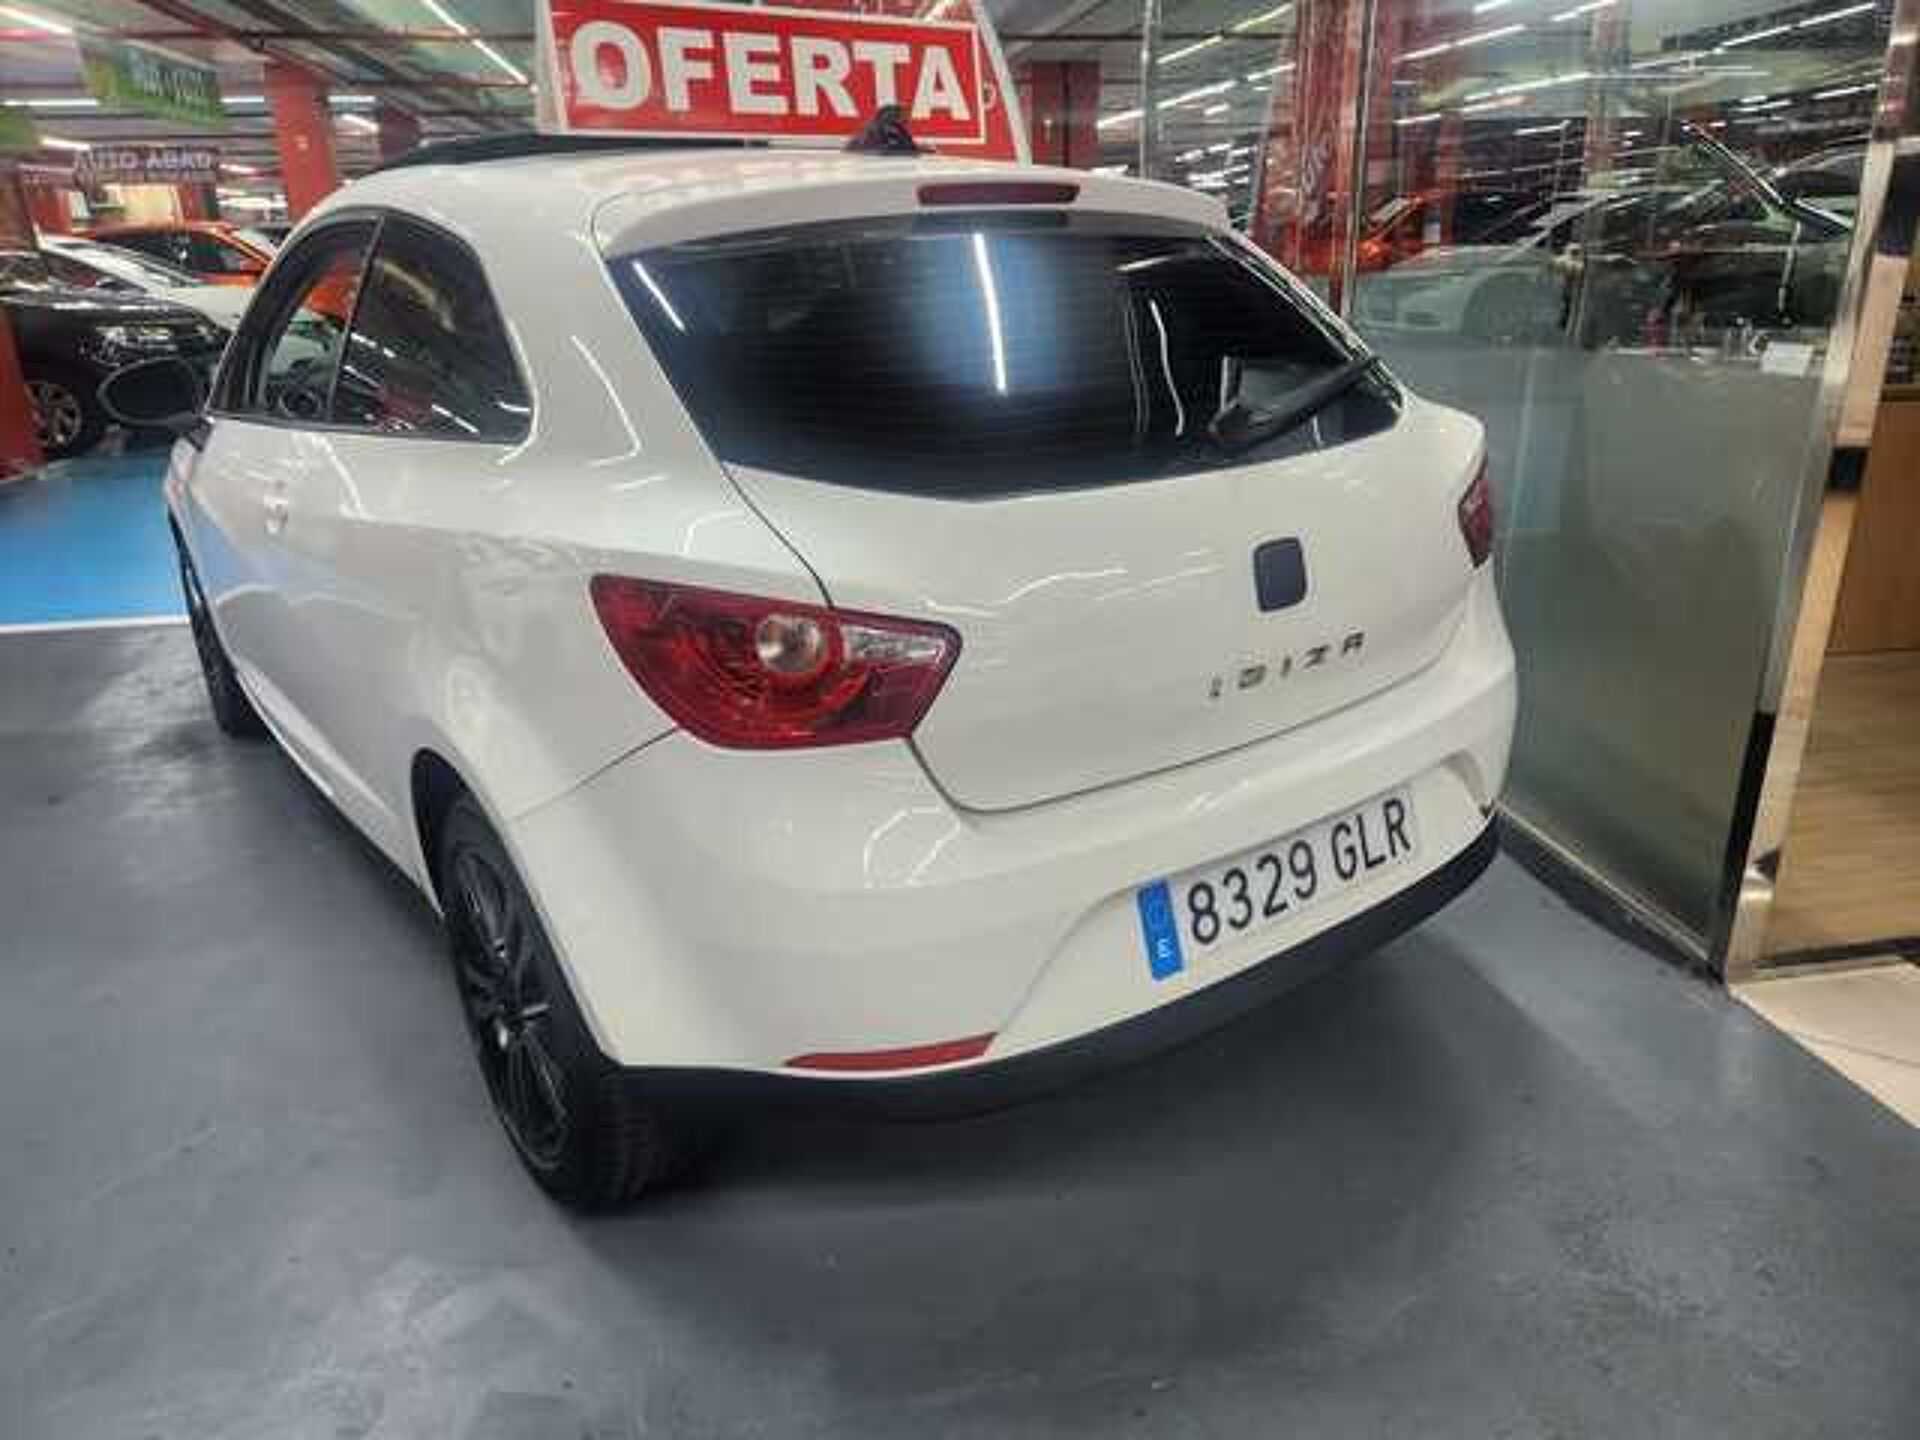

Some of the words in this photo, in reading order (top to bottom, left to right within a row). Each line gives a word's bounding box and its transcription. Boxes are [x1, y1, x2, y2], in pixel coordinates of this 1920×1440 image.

[571, 20, 971, 121] OFERTA
[1208, 630, 1365, 698] IBIZA
[1187, 839, 1318, 945] 8329
[1331, 797, 1411, 881] GLR
